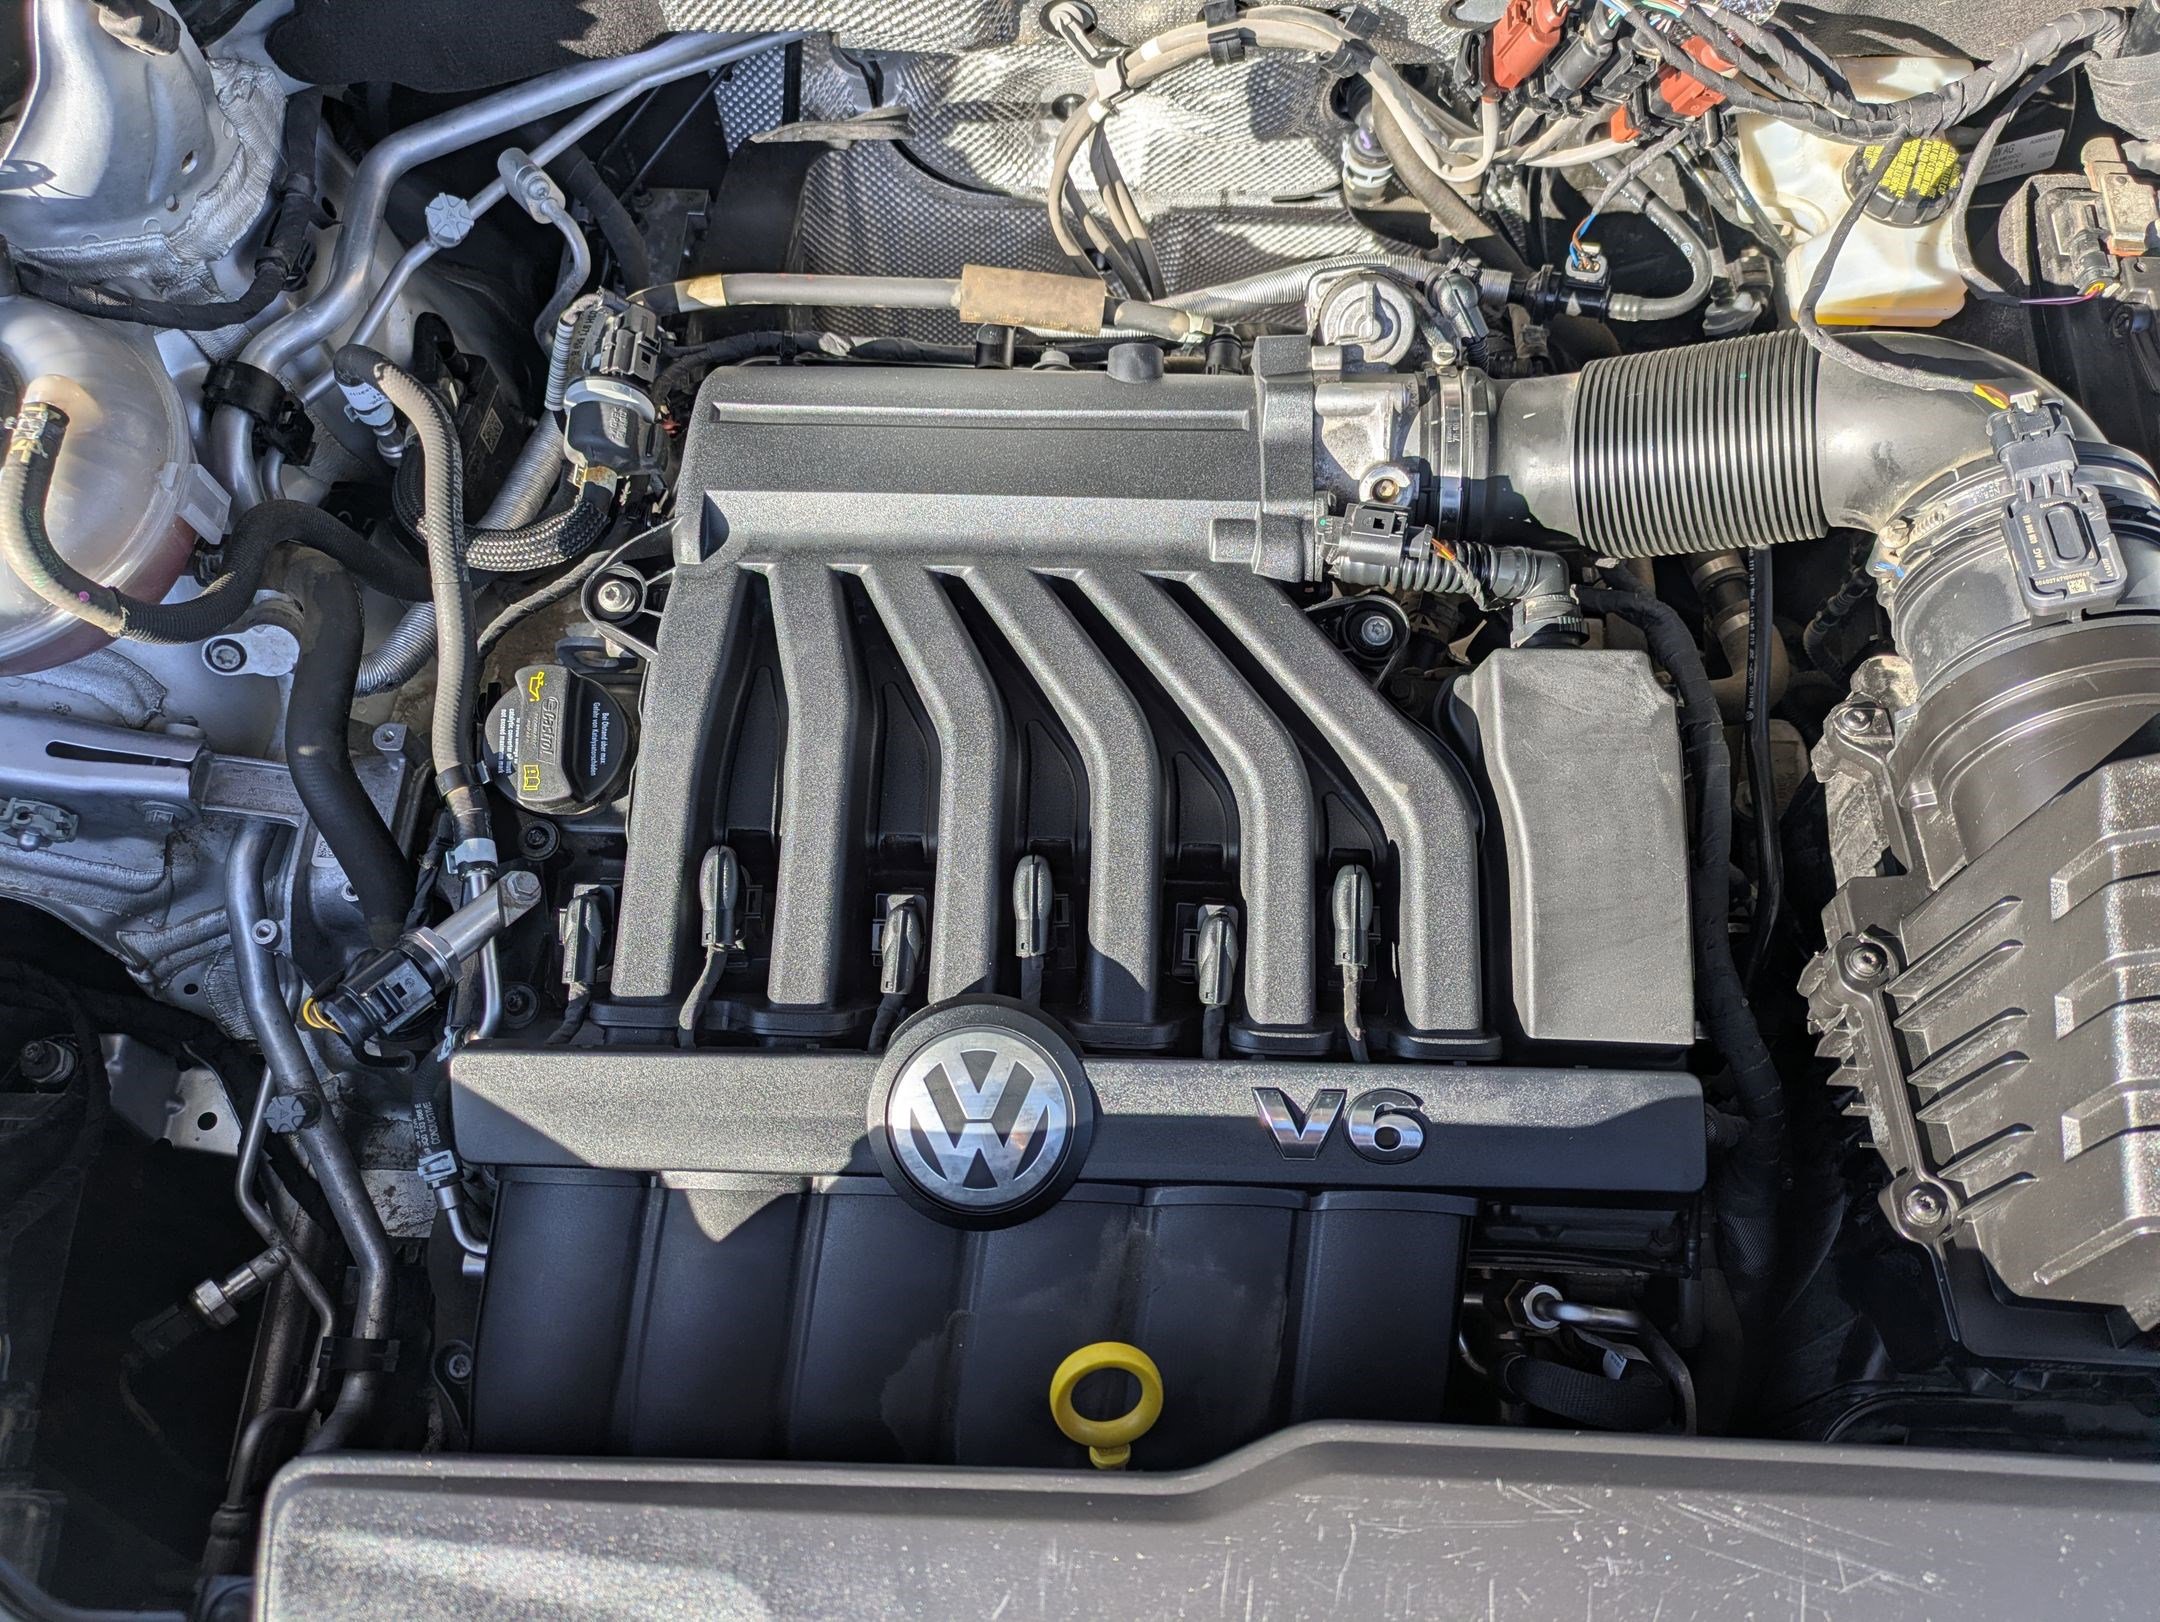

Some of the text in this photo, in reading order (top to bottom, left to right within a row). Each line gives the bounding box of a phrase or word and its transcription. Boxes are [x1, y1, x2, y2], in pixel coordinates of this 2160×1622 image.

[2003, 144, 2015, 154] AG
[2032, 547, 2043, 558] AG
[507, 708, 516, 728] catalytic
[592, 702, 601, 718] Gefahr
[601, 712, 609, 720] Bei
[499, 718, 507, 734] exceed
[541, 708, 556, 755] Castrol
[497, 735, 505, 759] maximum
[506, 729, 514, 752] converter
[423, 1101, 440, 1145] CONDUCTIVE
[890, 1028, 1068, 1206] VW
[1251, 1086, 1428, 1165] V6
